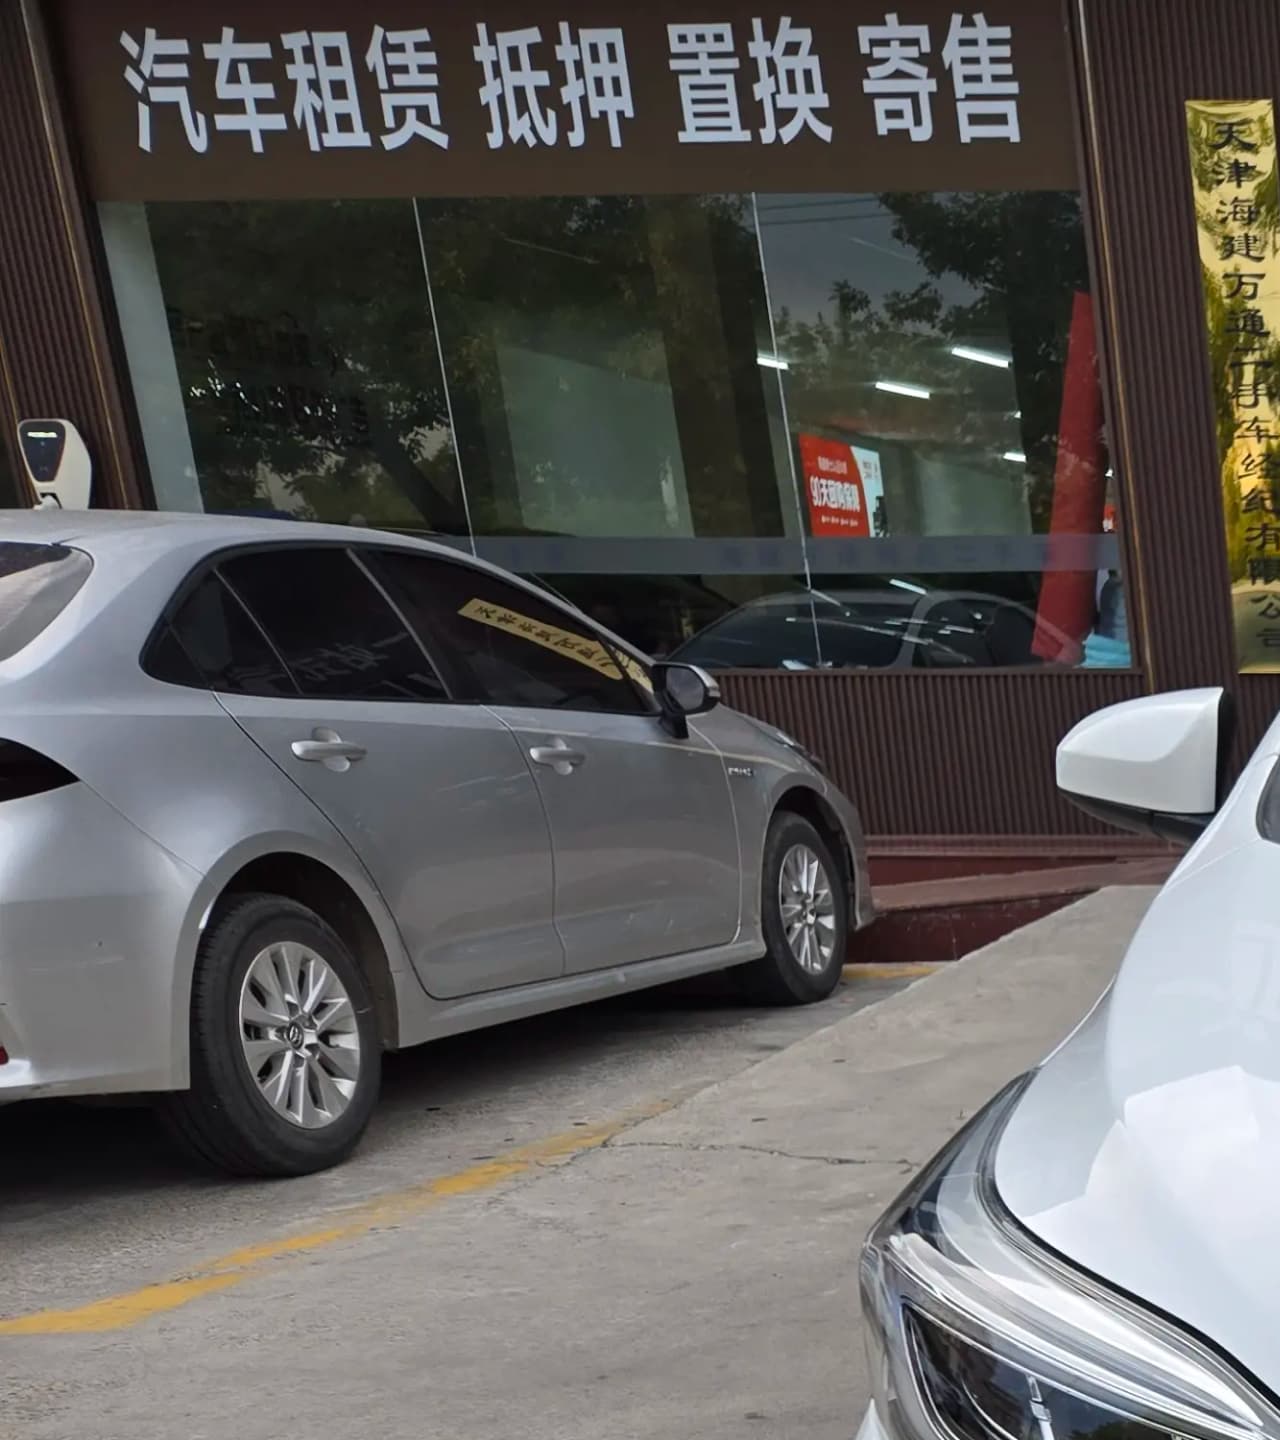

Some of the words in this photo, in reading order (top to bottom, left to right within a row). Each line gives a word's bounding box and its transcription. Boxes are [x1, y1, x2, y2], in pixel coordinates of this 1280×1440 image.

[121, 26, 449, 153] 汽车租赁
[474, 23, 634, 149] 抵押
[668, 18, 833, 145] 置换
[858, 14, 1021, 143] 寄售
